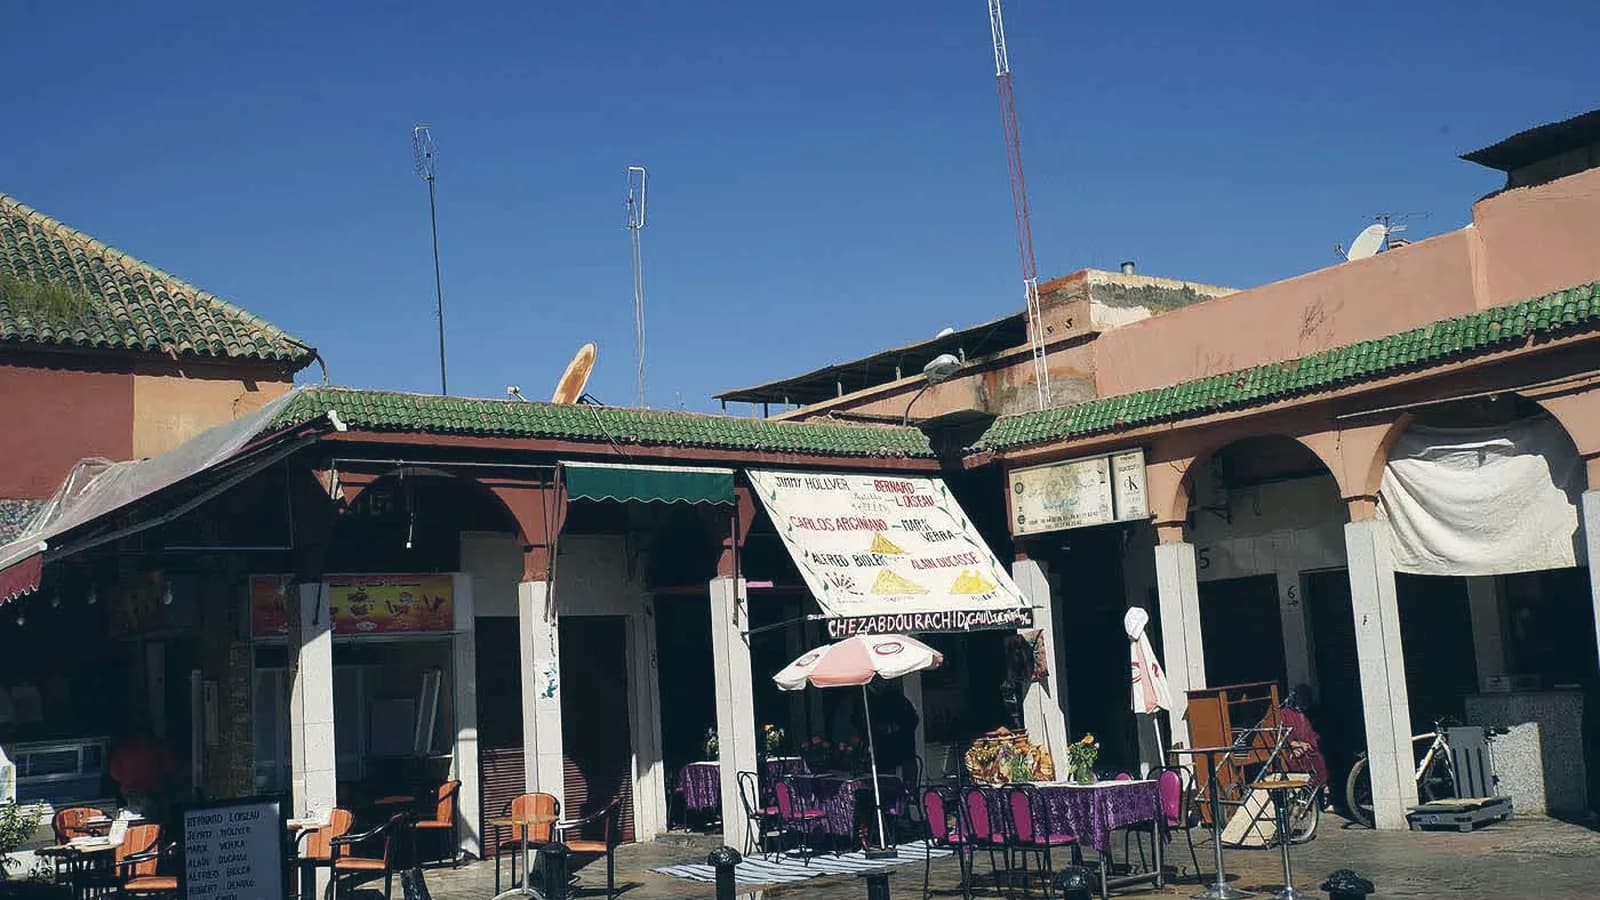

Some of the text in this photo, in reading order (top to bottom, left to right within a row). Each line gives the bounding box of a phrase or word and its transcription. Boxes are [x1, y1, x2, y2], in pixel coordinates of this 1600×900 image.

[873, 480, 915, 495] BERNARD
[789, 515, 835, 532] CARLOS
[811, 553, 849, 569] ALFRED
[911, 551, 981, 571] ALAIN DUCASSE
[1199, 548, 1210, 570] 5
[828, 618, 867, 638] CHEZ
[867, 613, 912, 634] ABDOU
[914, 610, 965, 631] RACHID
